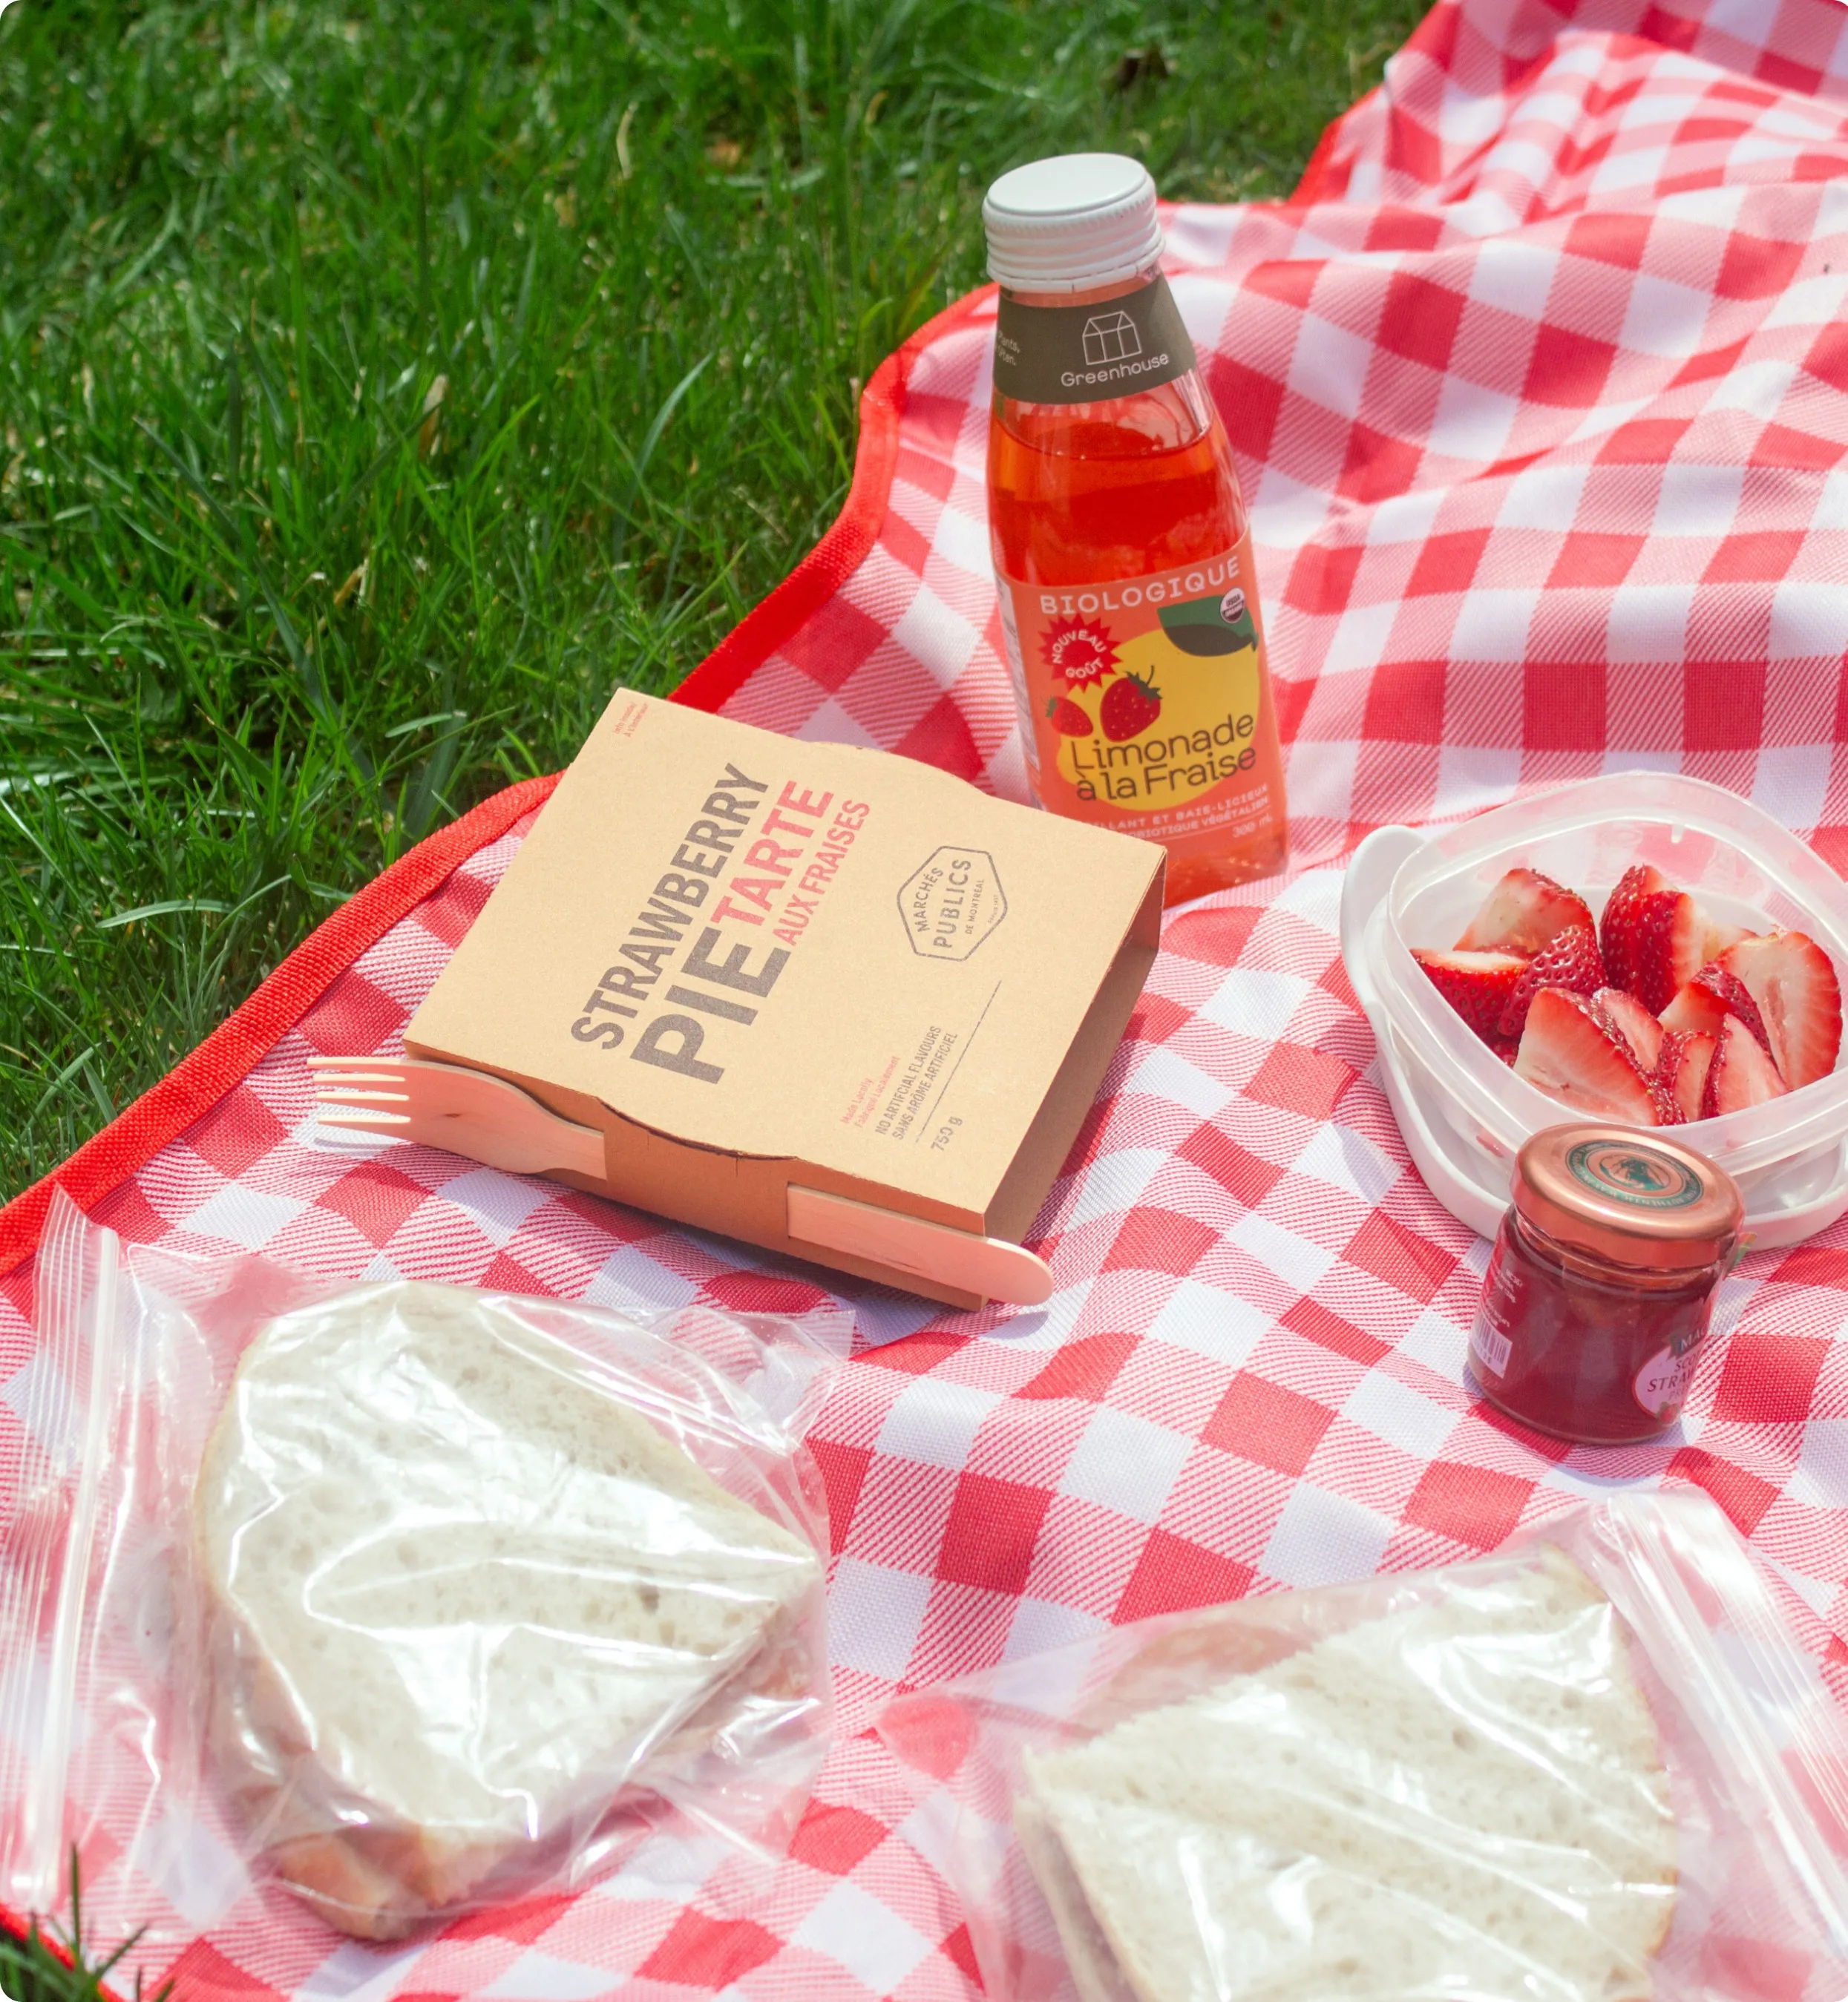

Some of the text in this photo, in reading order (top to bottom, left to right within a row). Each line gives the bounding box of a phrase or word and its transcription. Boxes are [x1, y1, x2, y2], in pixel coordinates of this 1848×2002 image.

[1061, 352, 1170, 387] Greenhouse
[1040, 556, 1240, 614] BIOLOGIQUE
[1052, 629, 1107, 663] NOUVEAU
[1065, 657, 1105, 679] GOÛT
[1071, 713, 1254, 771] Limonade
[1076, 746, 1256, 801] à la Fraise
[1152, 813, 1169, 825] ET
[1176, 784, 1268, 821] BAIE-LICIEUX
[773, 799, 870, 947] AUX FRAISES
[914, 867, 944, 932] MARCHÉS
[571, 762, 768, 1050] STRAWBERRY
[629, 780, 834, 1085] PIE TARTE
[933, 859, 971, 948] PUBLICS
[965, 925, 974, 935] DE
[852, 1077, 874, 1105] Locally
[874, 1120, 891, 1135] NO
[908, 1025, 941, 1074] FLAVOURS
[892, 1032, 958, 1140] SANS ARÔME ARTIFICIEL
[930, 1115, 963, 1152] 750 g
